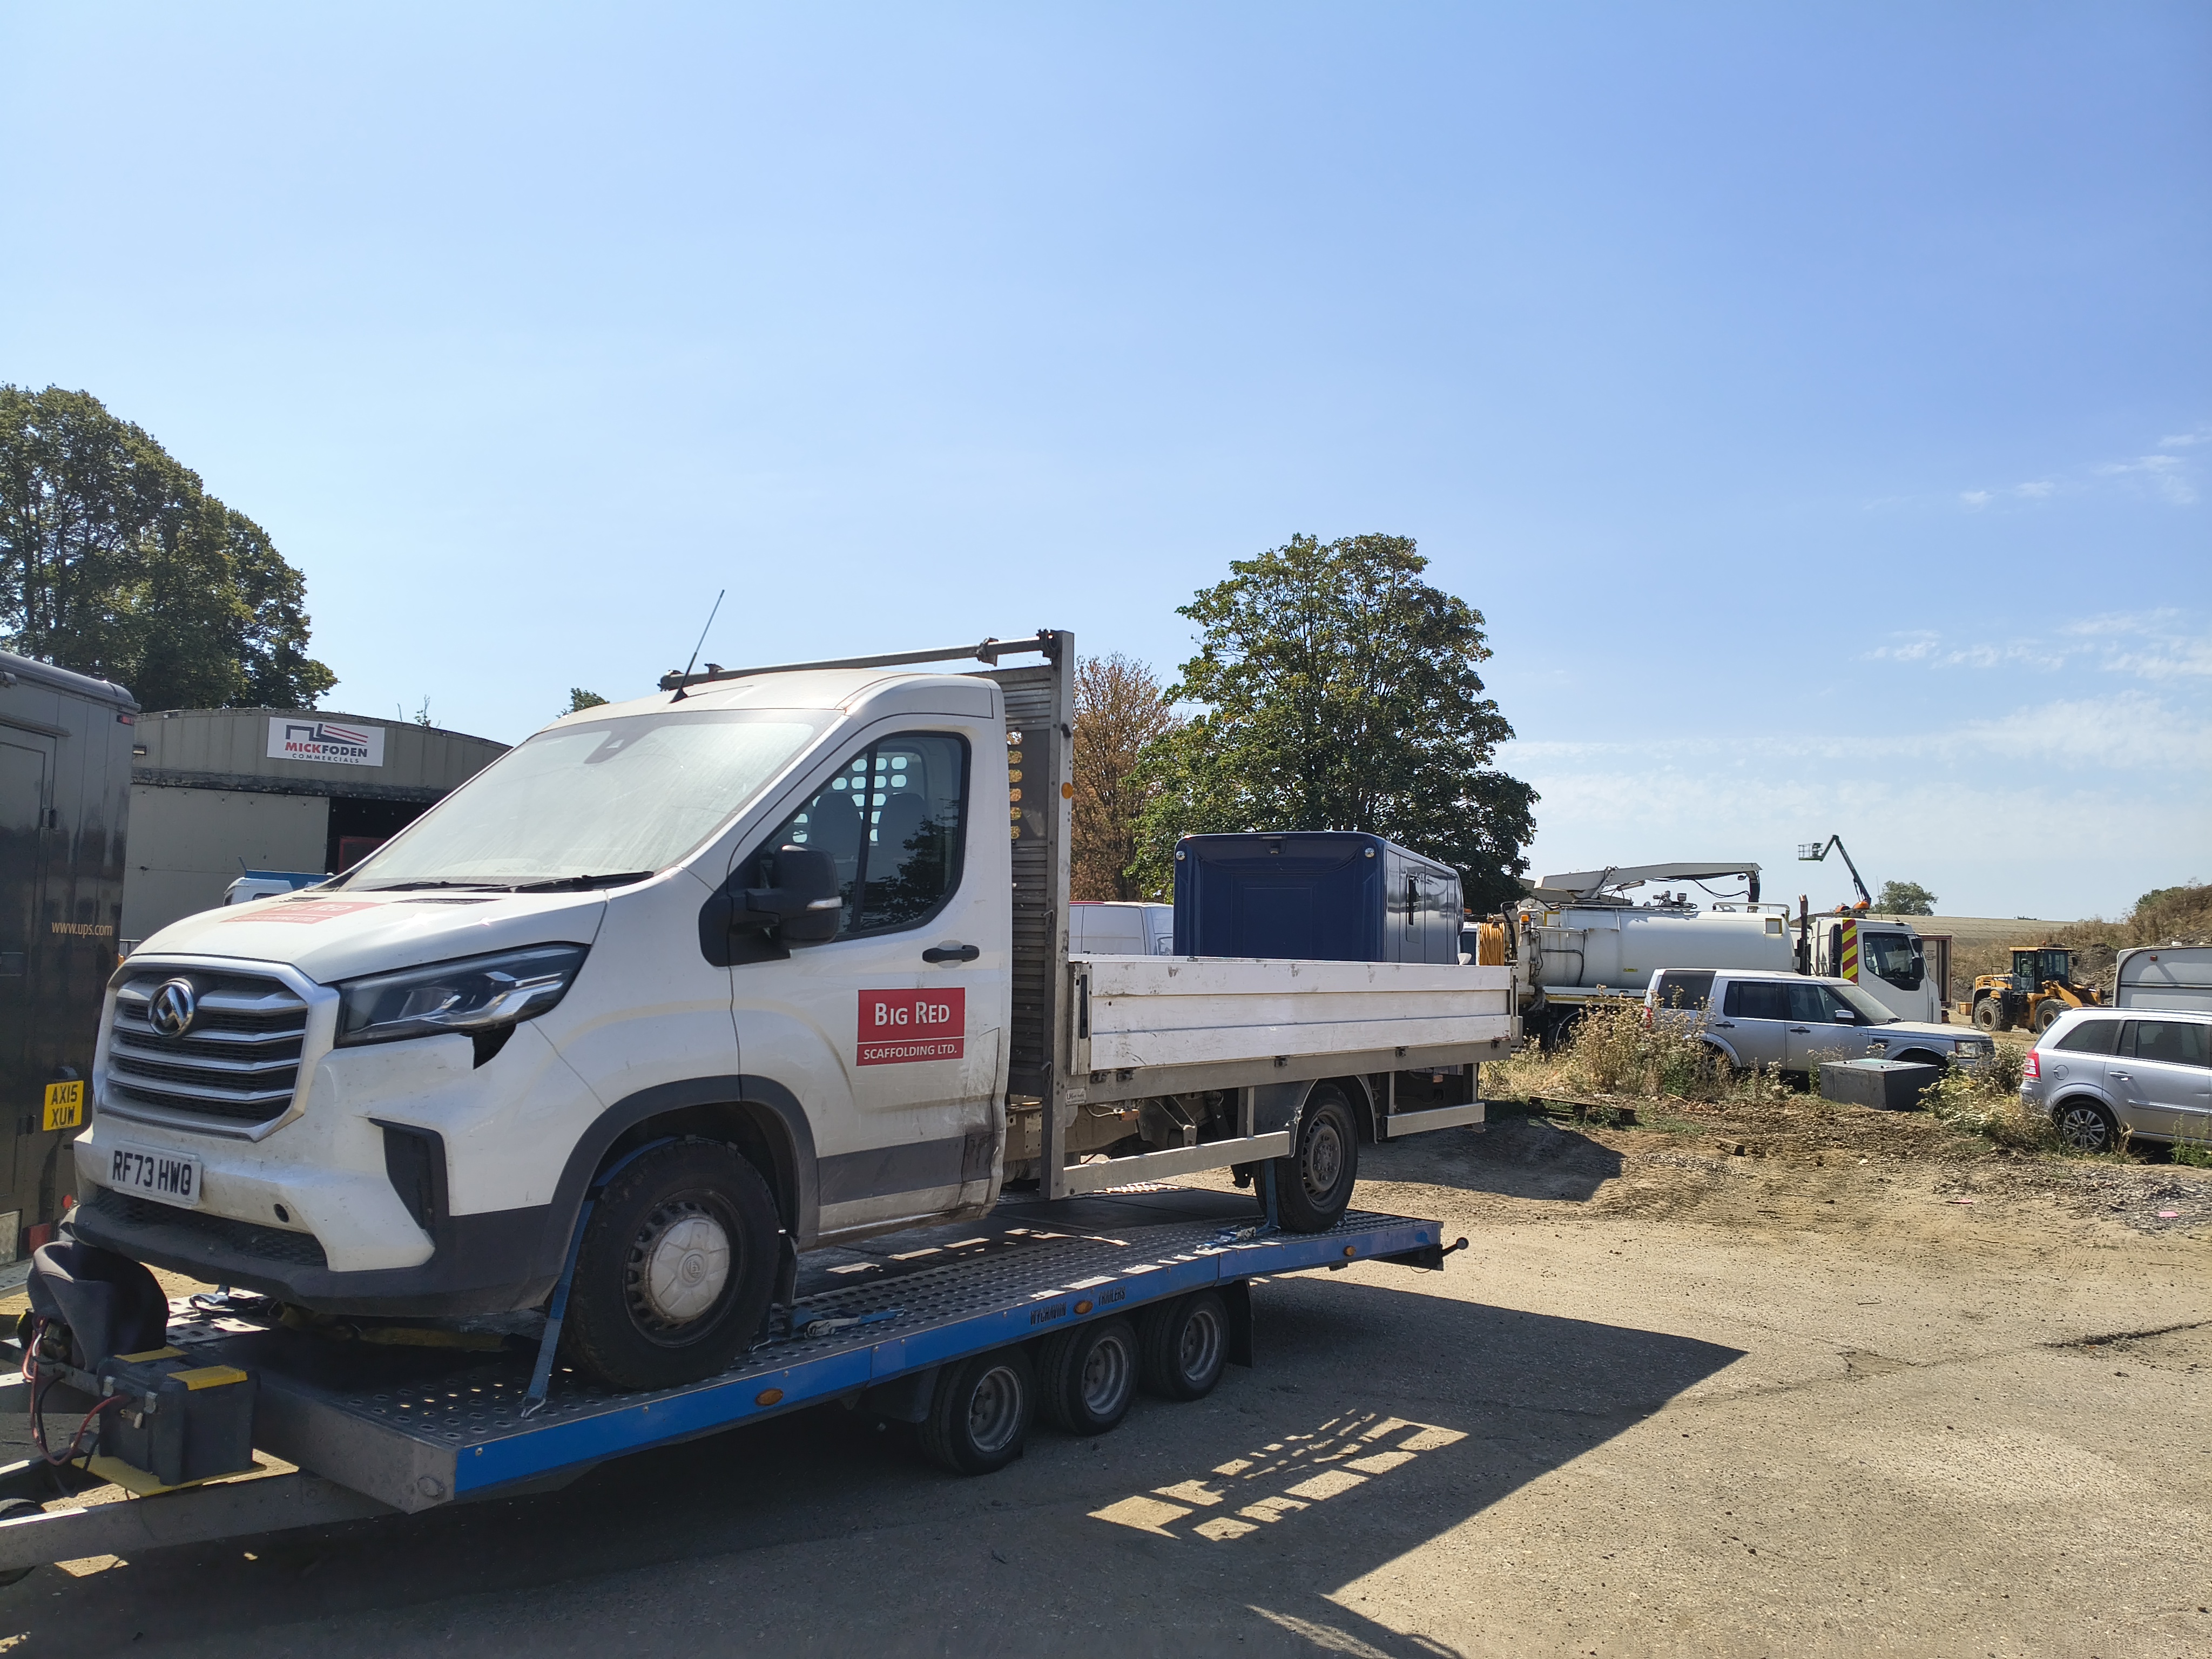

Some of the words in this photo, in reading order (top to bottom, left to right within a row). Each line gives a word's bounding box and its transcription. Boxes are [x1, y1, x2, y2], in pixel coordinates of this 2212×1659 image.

[292, 753, 359, 763] COMMERCIALS
[52, 922, 112, 939] www.ups.com
[864, 1046, 935, 1060] SCAFFOLDING
[938, 1044, 957, 1054] LTD.
[51, 1084, 78, 1105] AX15
[51, 1106, 75, 1127] XUW
[112, 1150, 154, 1187] RF73
[1098, 1286, 1127, 1306] TRAILERS
